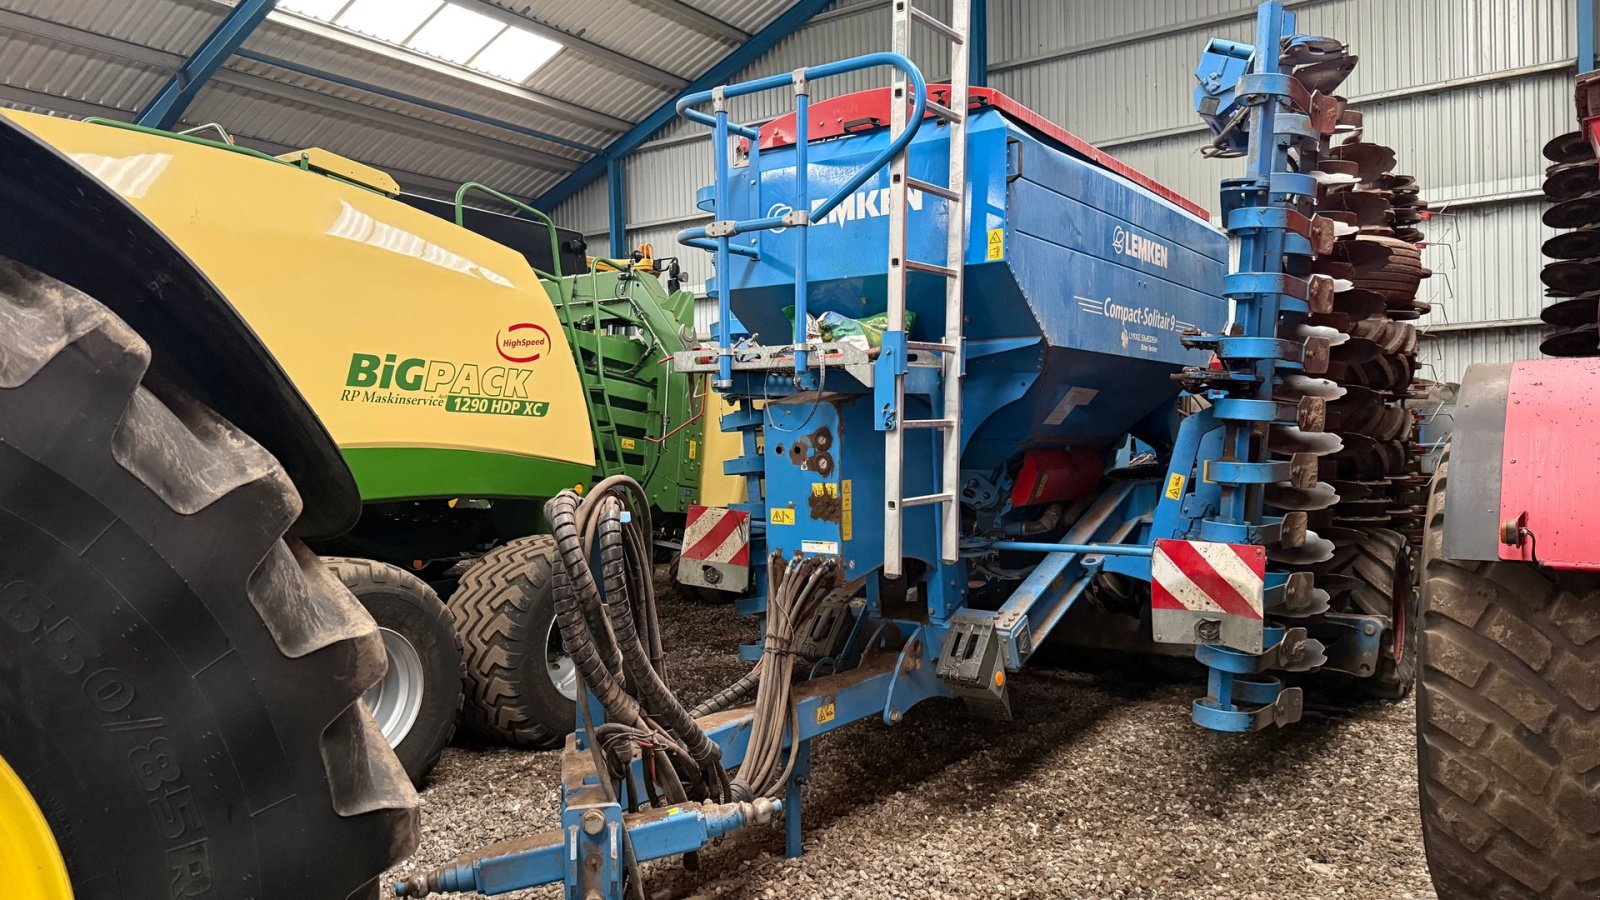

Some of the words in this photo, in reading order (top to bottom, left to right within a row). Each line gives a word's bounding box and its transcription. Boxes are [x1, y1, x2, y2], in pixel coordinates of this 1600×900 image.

[1125, 231, 1168, 268] LEMKEN
[1104, 297, 1170, 331] Compact-Solitair
[1170, 314, 1176, 331] 9
[503, 337, 545, 349] HighSpeed
[341, 389, 361, 402] RP
[362, 390, 444, 407] Maskinservice
[454, 398, 489, 413] 1290
[490, 399, 520, 414] HDP
[523, 402, 543, 416] XC
